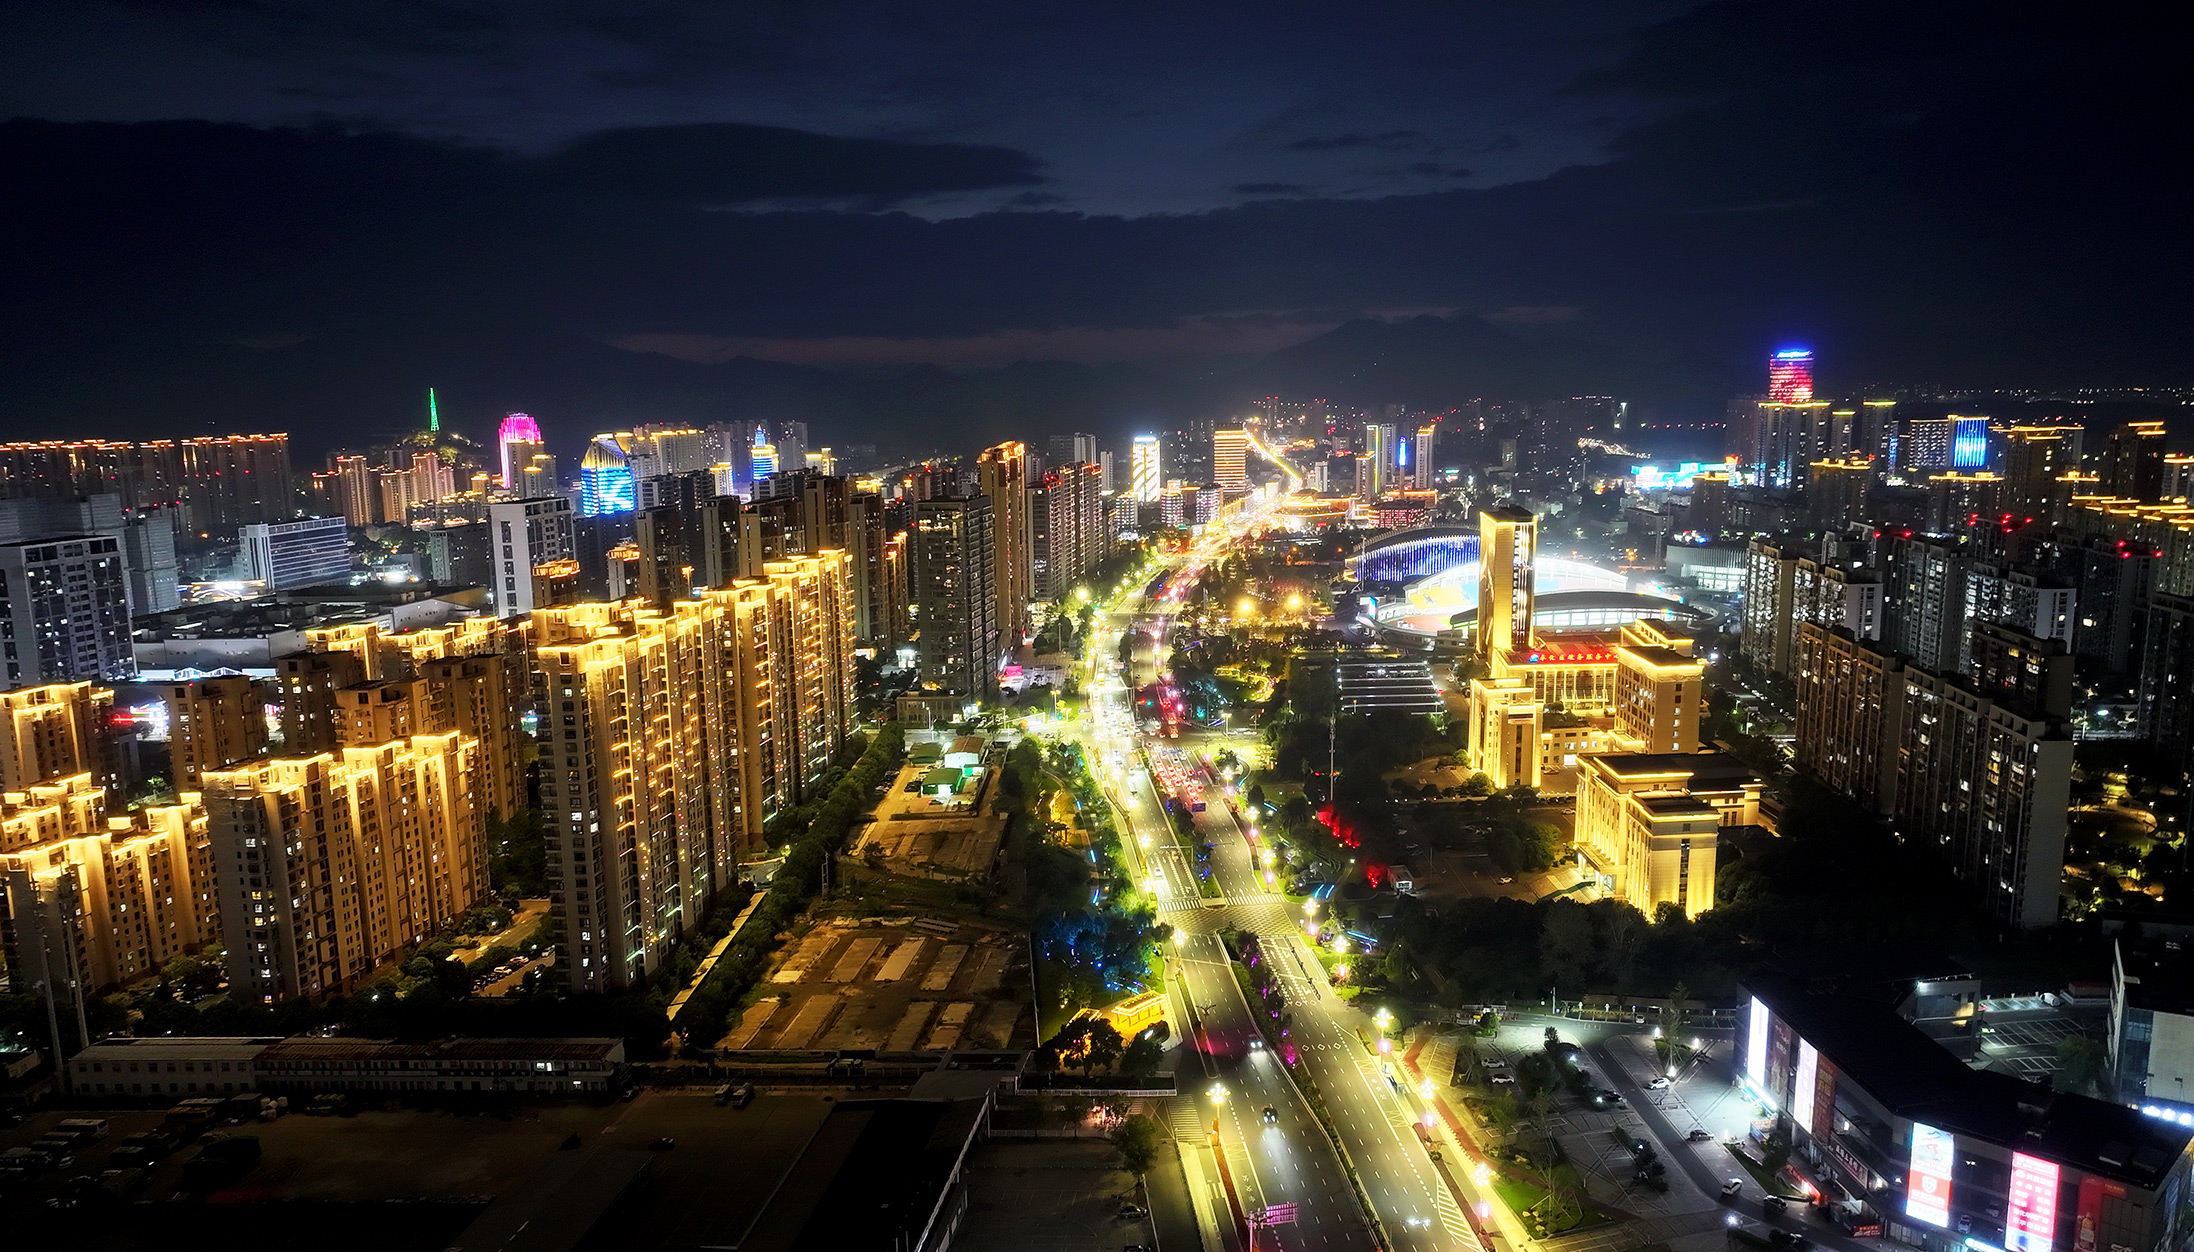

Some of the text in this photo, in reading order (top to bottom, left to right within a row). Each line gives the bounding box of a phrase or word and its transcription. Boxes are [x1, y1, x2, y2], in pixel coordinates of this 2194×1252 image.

[1540, 652, 1619, 662] 奉化区政务服务中心
